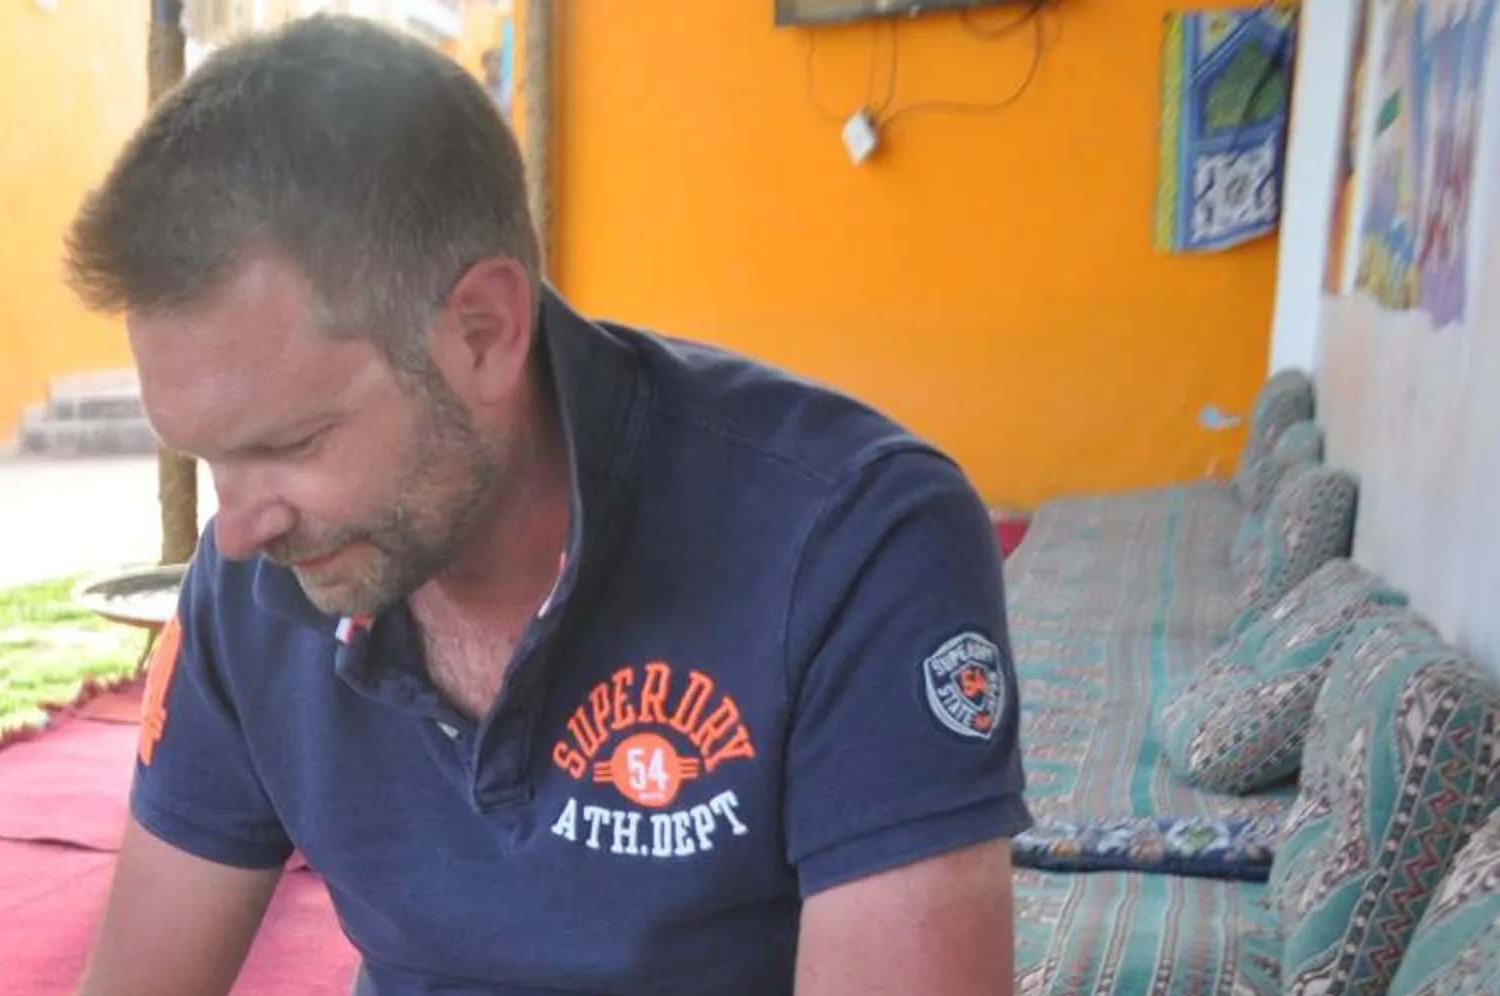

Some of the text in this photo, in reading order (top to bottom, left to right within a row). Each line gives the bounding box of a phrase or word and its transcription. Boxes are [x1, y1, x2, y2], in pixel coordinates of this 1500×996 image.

[552, 662, 756, 780] SUPERDRY
[627, 747, 670, 793] 54
[551, 789, 748, 857] ATH.DEPT
